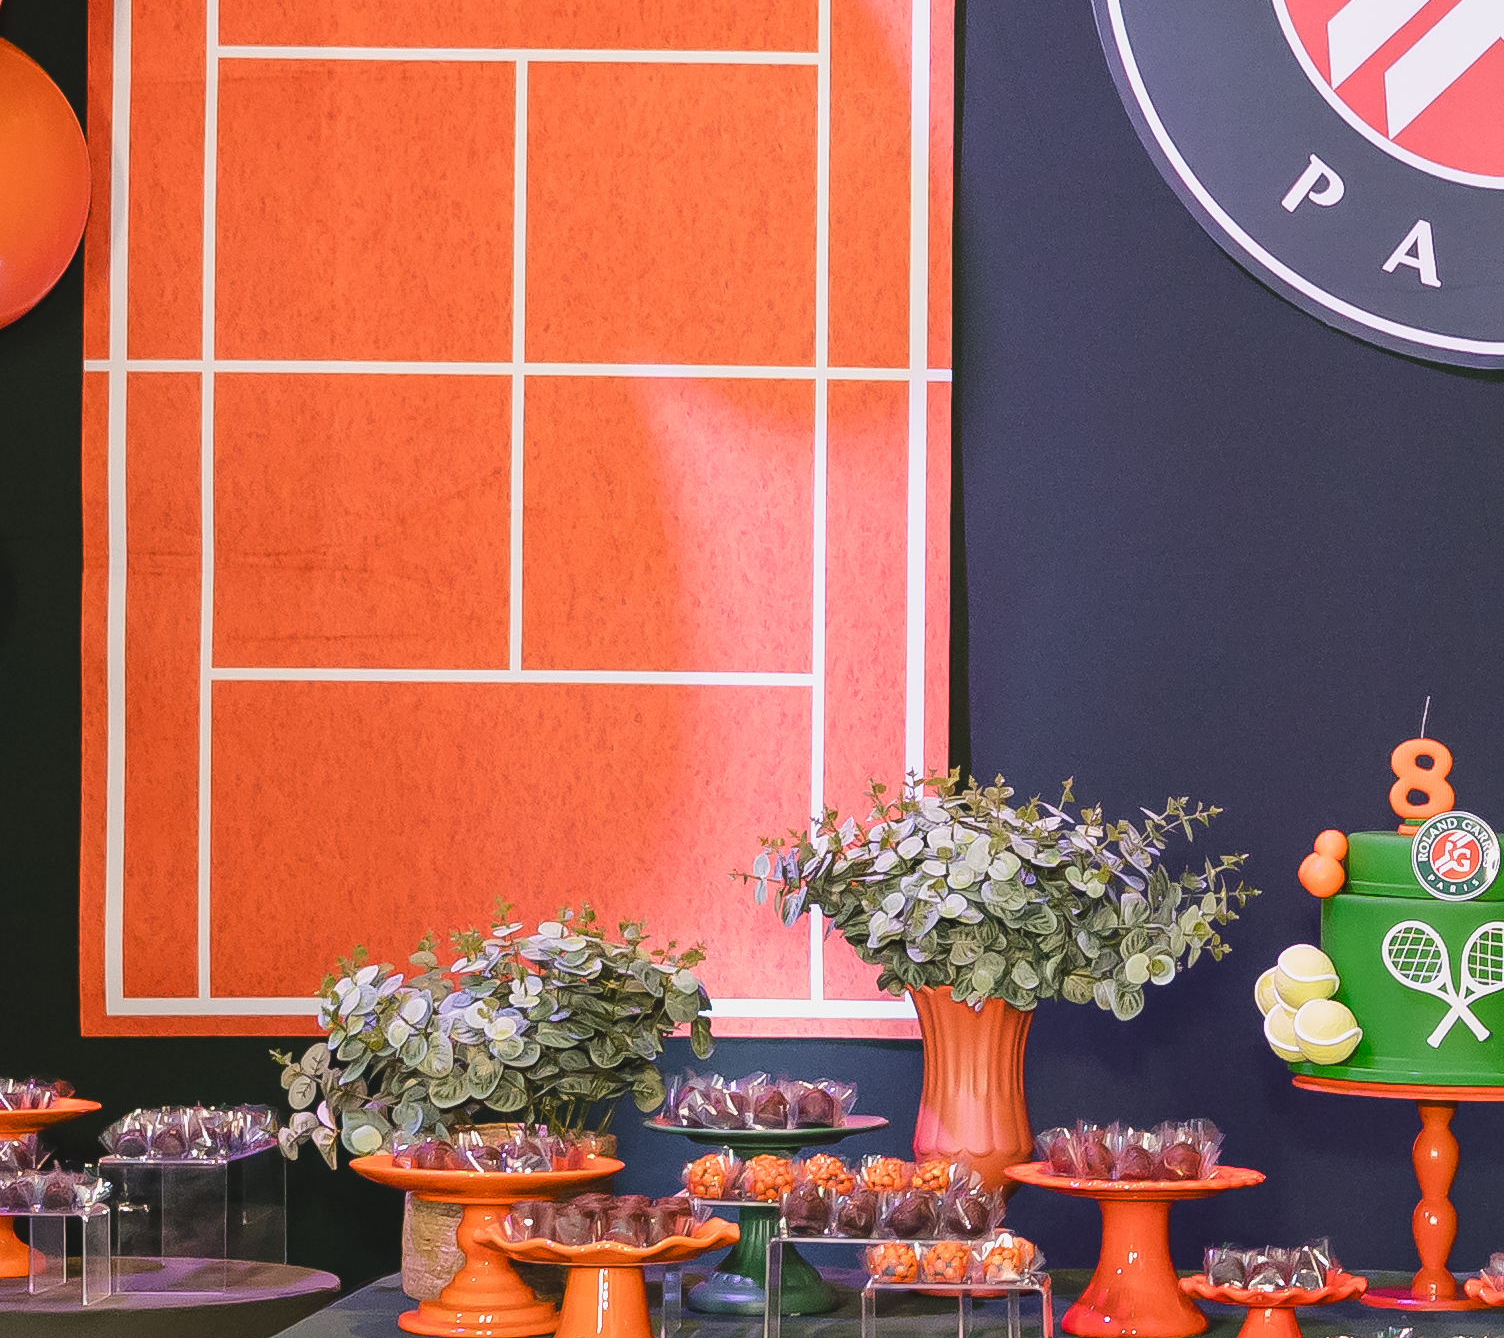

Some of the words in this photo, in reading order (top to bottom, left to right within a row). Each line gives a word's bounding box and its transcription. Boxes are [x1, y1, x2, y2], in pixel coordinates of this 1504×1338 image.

[1389, 738, 1456, 819] 8
[1417, 818, 1458, 862] ROLAND
[1427, 873, 1480, 893] PARIS
